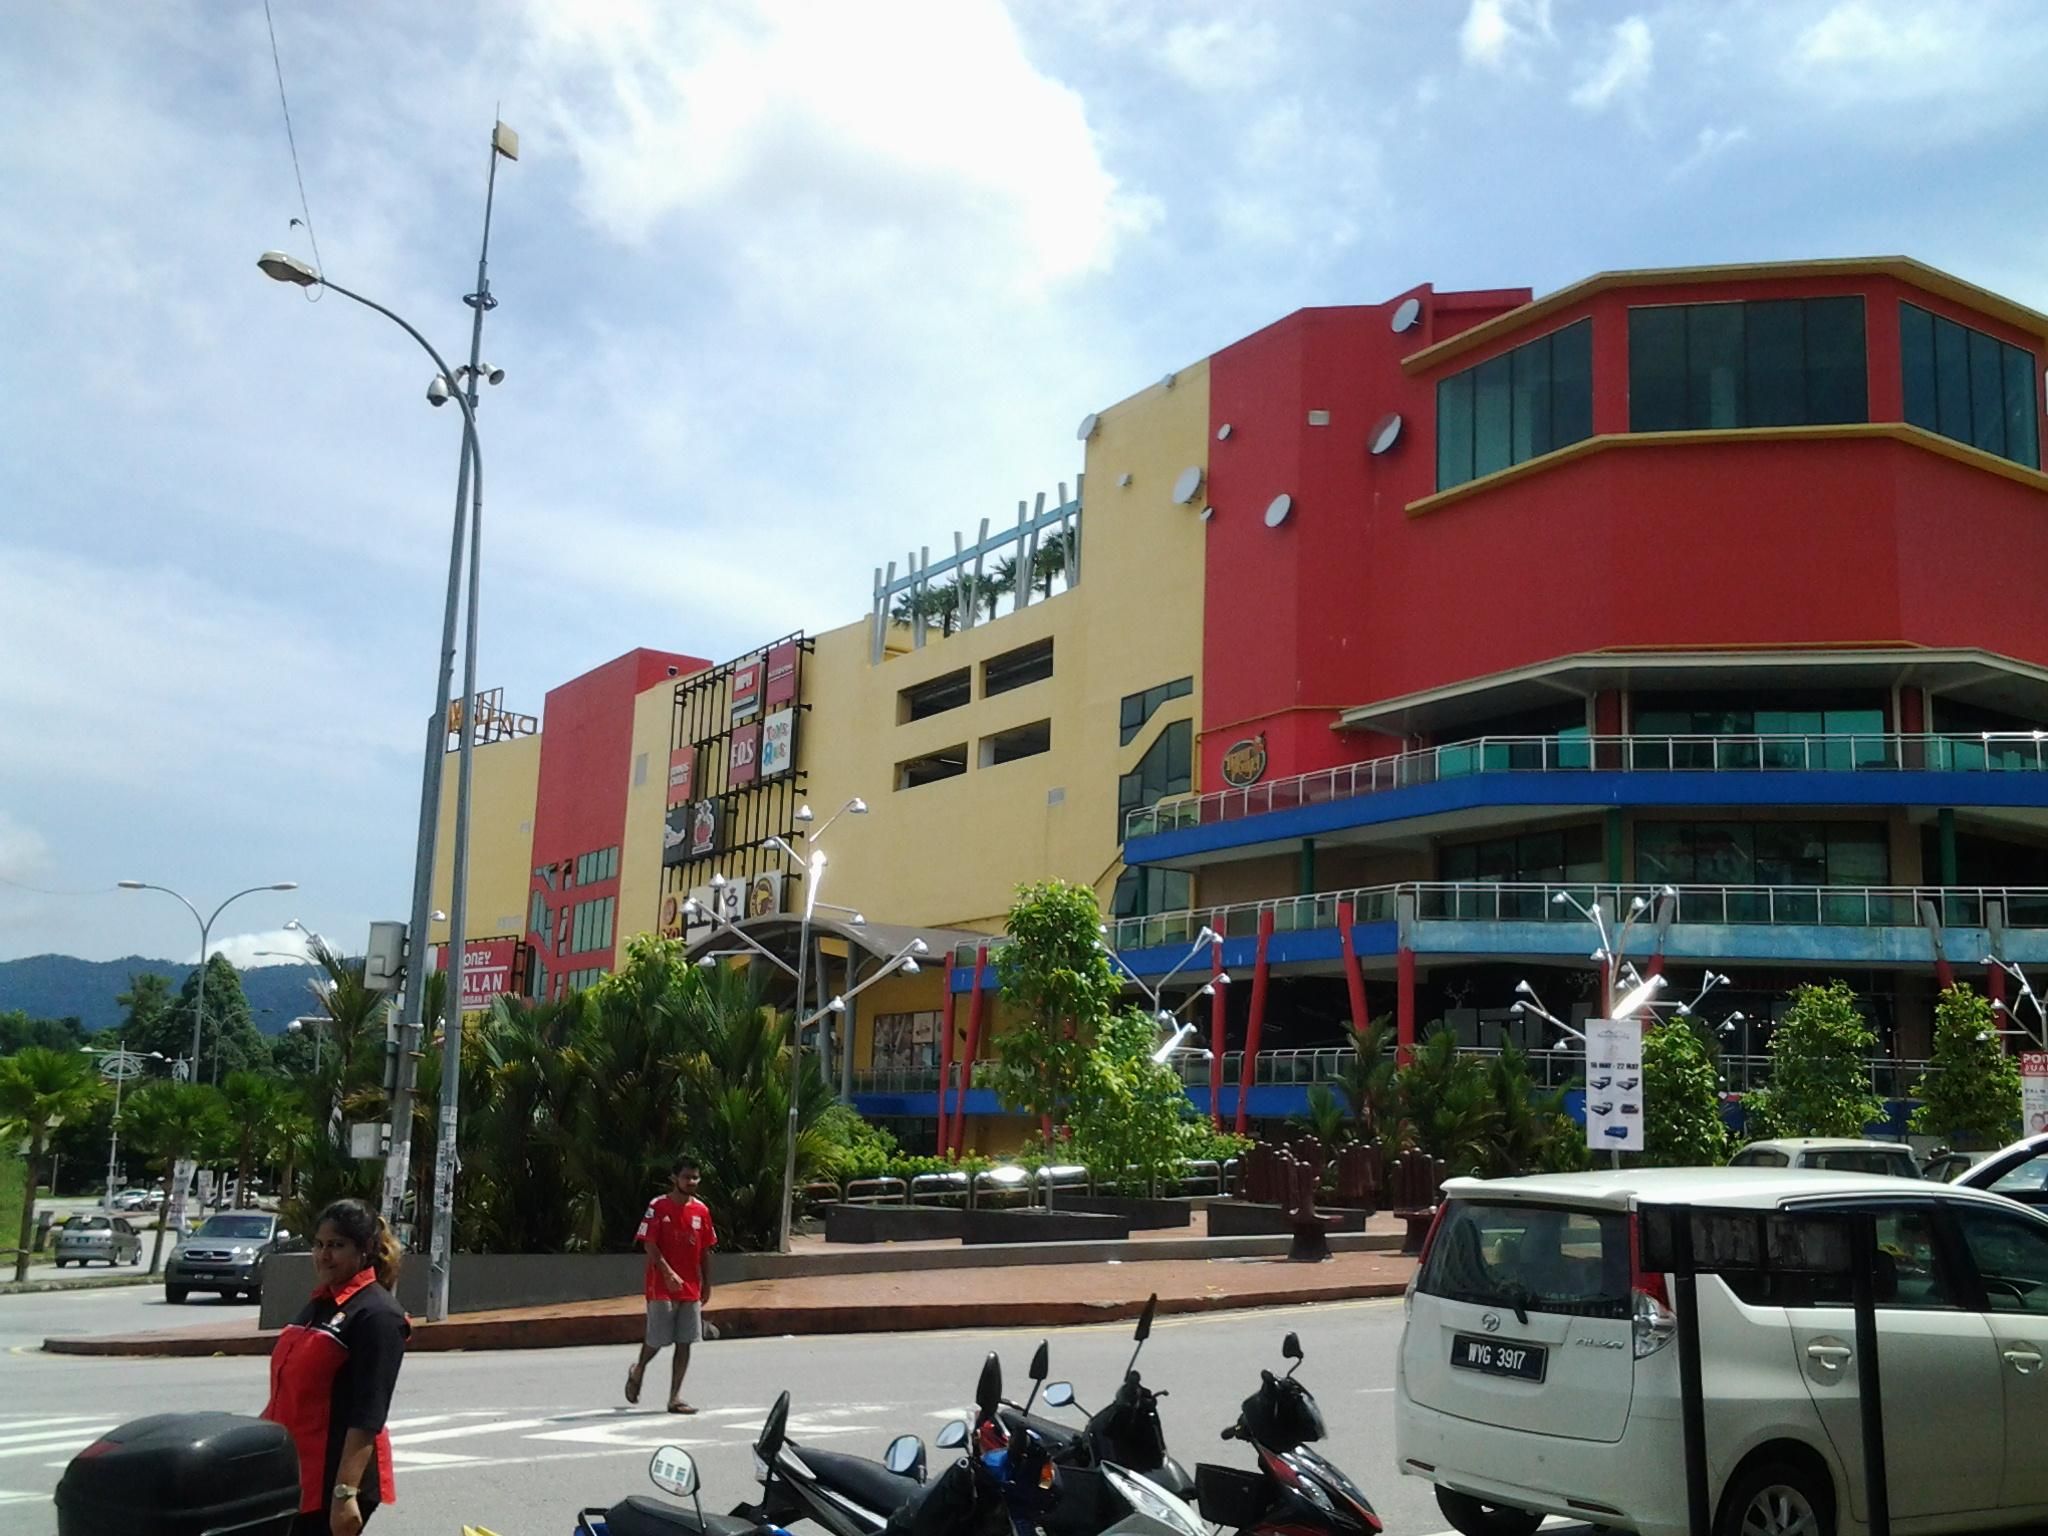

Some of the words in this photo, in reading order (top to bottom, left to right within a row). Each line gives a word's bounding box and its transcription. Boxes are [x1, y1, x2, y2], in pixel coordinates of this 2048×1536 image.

[464, 951, 492, 967] ONEY
[1468, 1343, 1491, 1364] WYG
[1497, 1348, 1526, 1369] 3917
